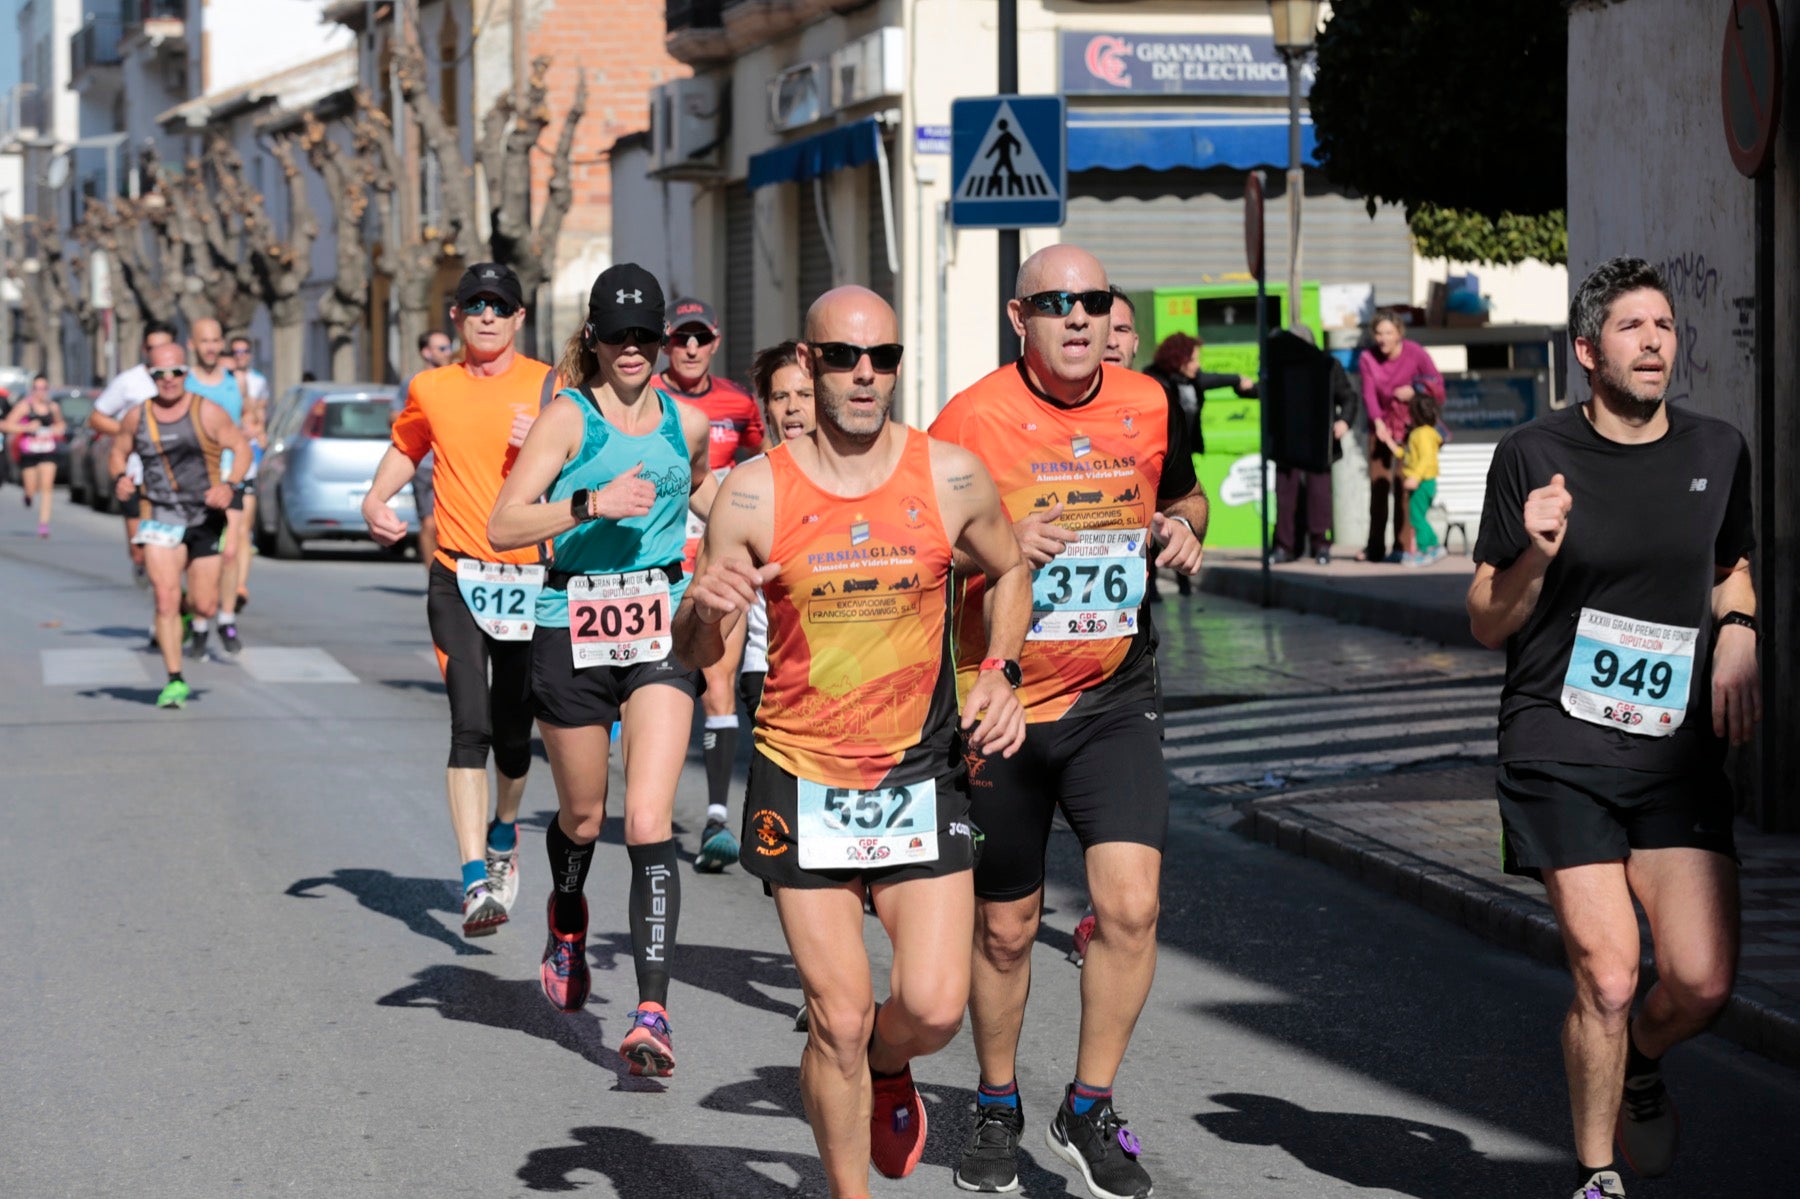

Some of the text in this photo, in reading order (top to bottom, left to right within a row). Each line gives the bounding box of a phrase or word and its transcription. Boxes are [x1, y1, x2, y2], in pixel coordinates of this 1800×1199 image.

[1136, 42, 1254, 62] GRANADINA
[1152, 62, 1182, 80] DE
[1085, 469, 1112, 479] Vidrio
[1060, 509, 1122, 521] EXCAVACIONES
[1080, 532, 1106, 544] PREMIO
[1106, 532, 1116, 544] DE
[807, 545, 917, 565] PERSIALGLASS
[1067, 544, 1110, 556] DIPUTACIÓN
[849, 561, 860, 569] de
[861, 558, 889, 568] Vidrio
[889, 557, 914, 565] Plano
[612, 575, 635, 587] PRMIO
[1047, 564, 1128, 605] 376
[471, 586, 526, 615] 612
[576, 599, 662, 637] 2031
[1612, 619, 1633, 634] GRAN
[1634, 624, 1662, 639] PREMIO
[1662, 628, 1672, 640] DE
[1619, 633, 1664, 651] DIPUTACIÓN
[1591, 650, 1673, 699] 949
[824, 786, 914, 830] 552
